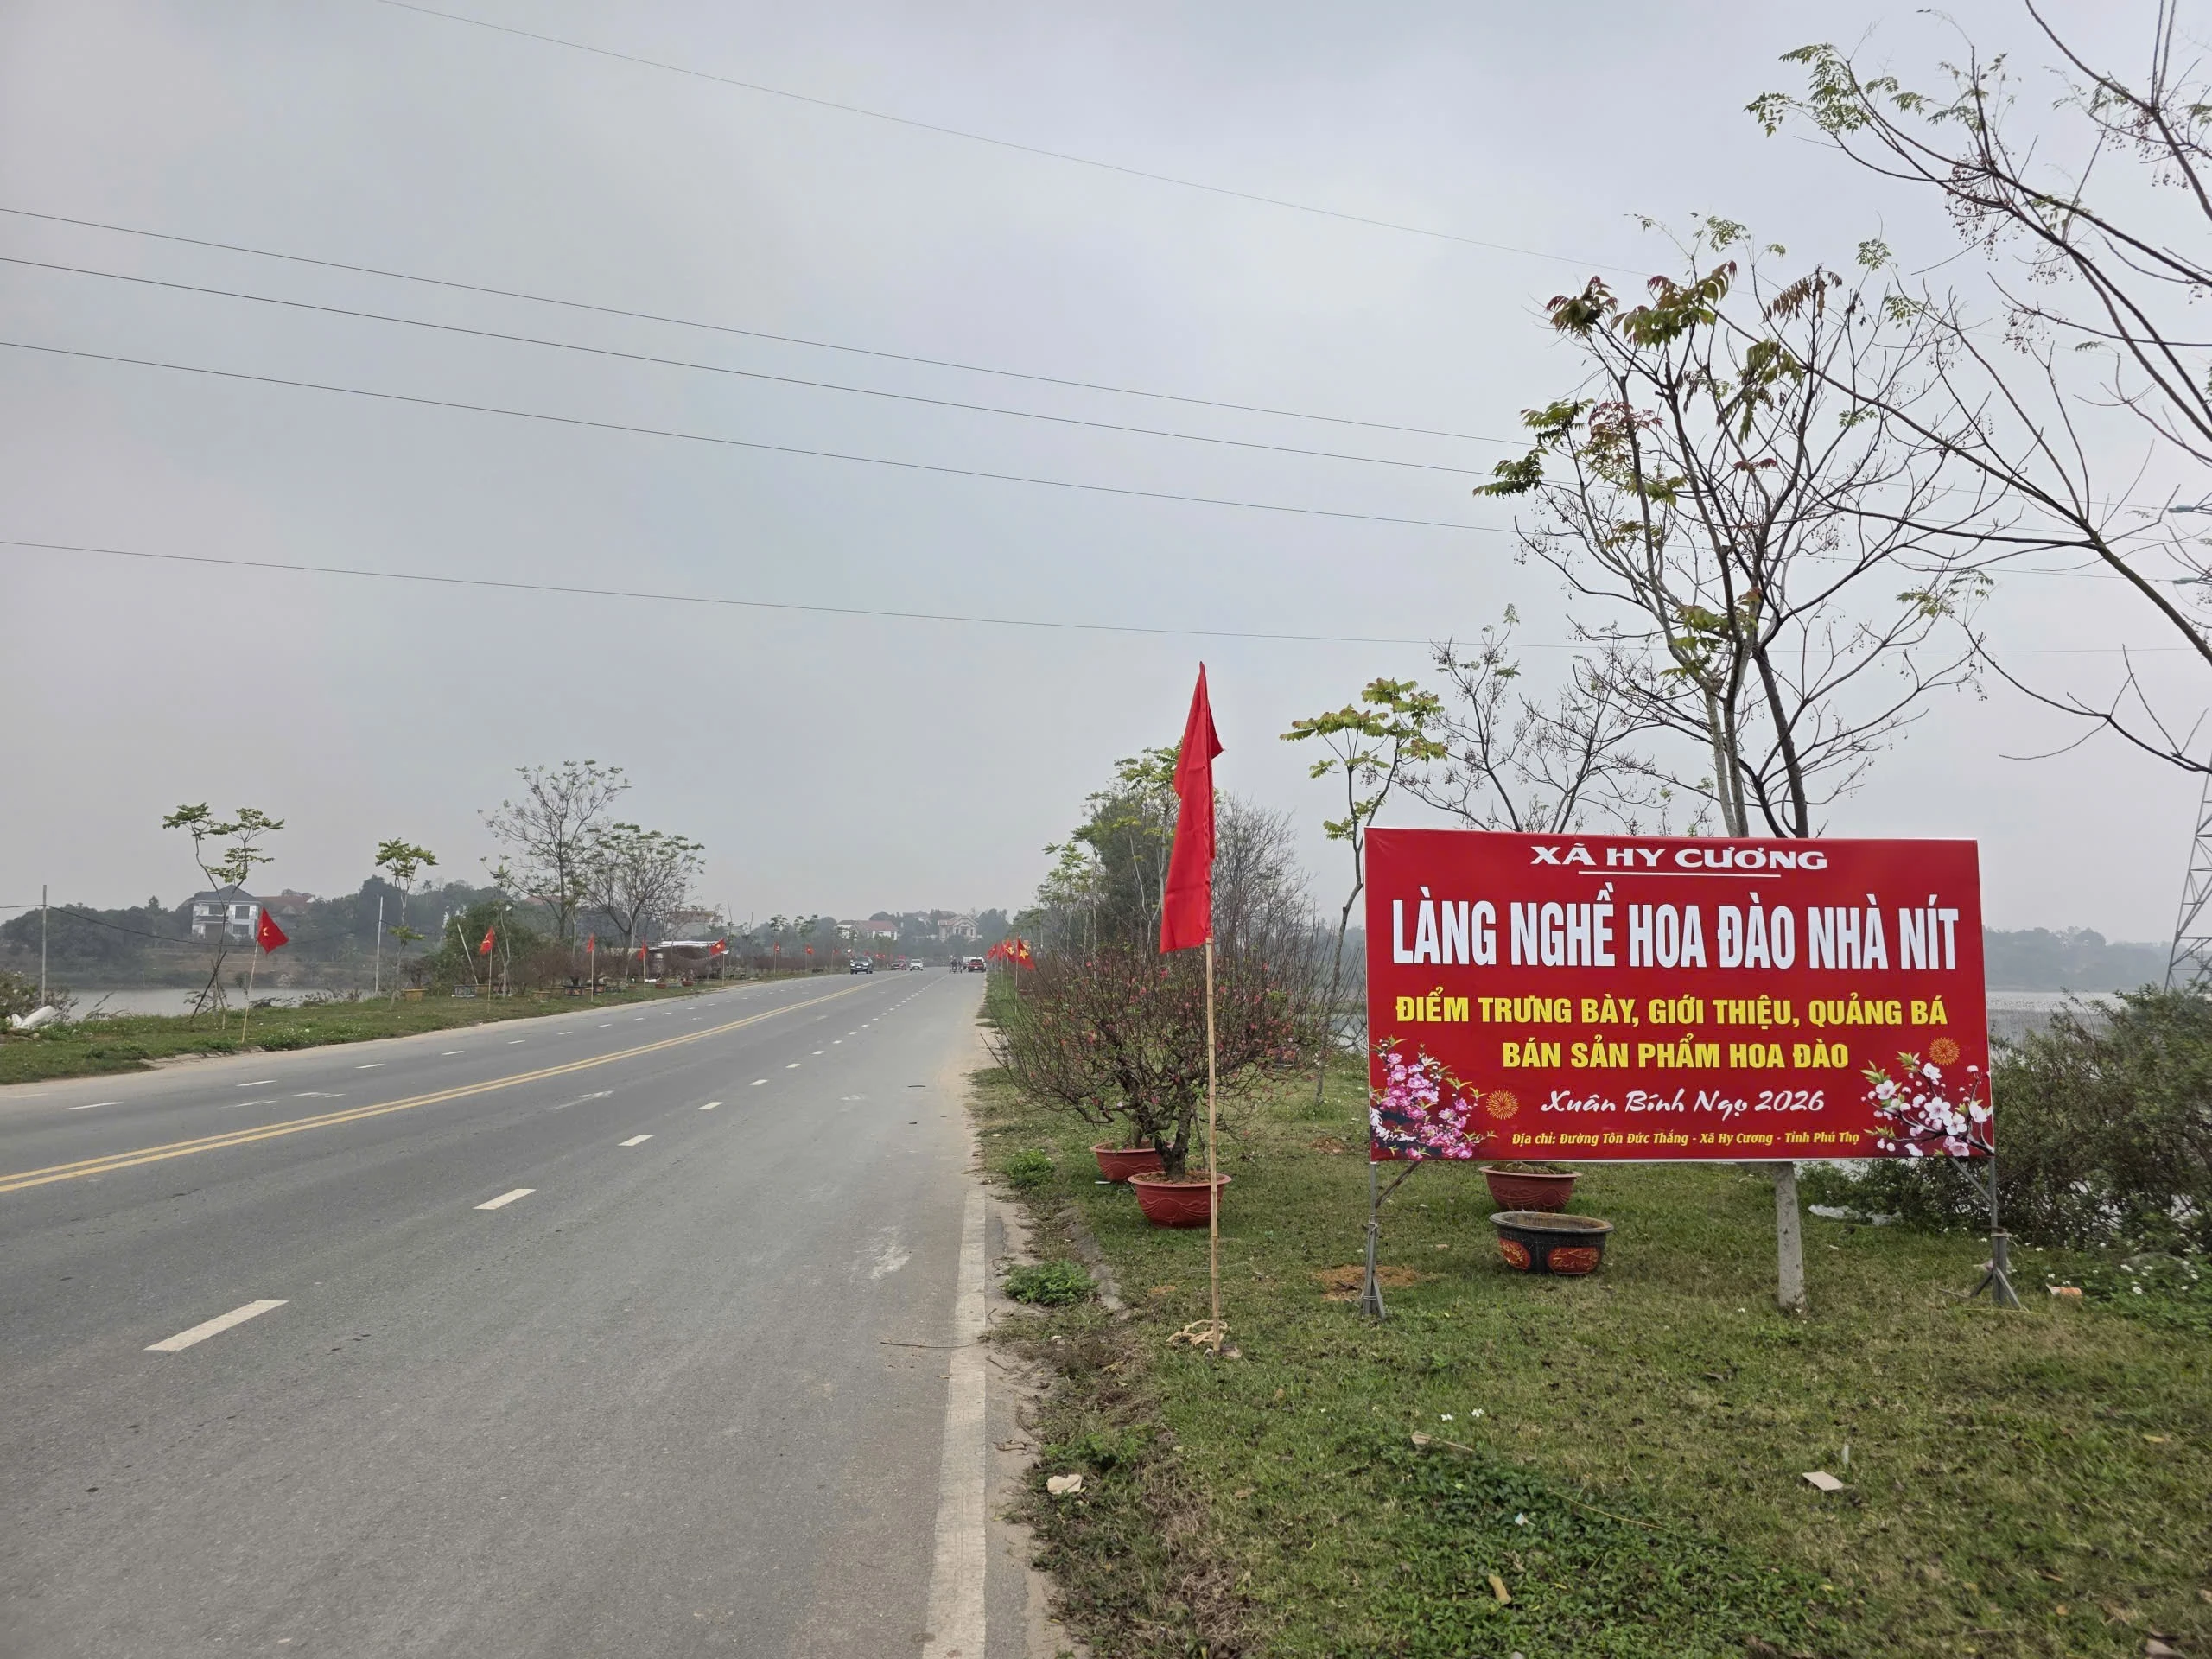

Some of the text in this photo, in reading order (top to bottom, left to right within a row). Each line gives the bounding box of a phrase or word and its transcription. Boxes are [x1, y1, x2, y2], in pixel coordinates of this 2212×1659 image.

[1530, 842, 1827, 869] XÃ HY CƯƠNG
[1393, 882, 1958, 969] LÀNG NGHỀ HOA ĐÀO NHÀ NÍT
[1395, 986, 1948, 1029] ĐIỂM TRƯNG BÀY, GIỚI THIỆU, QUẢNG BÁ
[1503, 1033, 1848, 1068] BÁN SẢN PHẨM HOA ĐÀO
[1541, 1089, 1824, 1121] Xuân Bính Ngọ 2026
[1512, 1133, 1532, 1147] Địa
[1535, 1131, 1556, 1144] chỉ:
[1560, 1133, 1599, 1147] Đường
[1603, 1132, 1623, 1144] Tôn
[1627, 1132, 1649, 1144] Đức
[1654, 1129, 1688, 1146] Thắng
[1700, 1132, 1715, 1144] Xã
[1719, 1133, 1734, 1147] Hy
[1736, 1133, 1773, 1146] Cương
[1785, 1130, 1809, 1143] Tỉnh
[1814, 1131, 1835, 1143] Phú
[1840, 1132, 1859, 1146] Thọ
